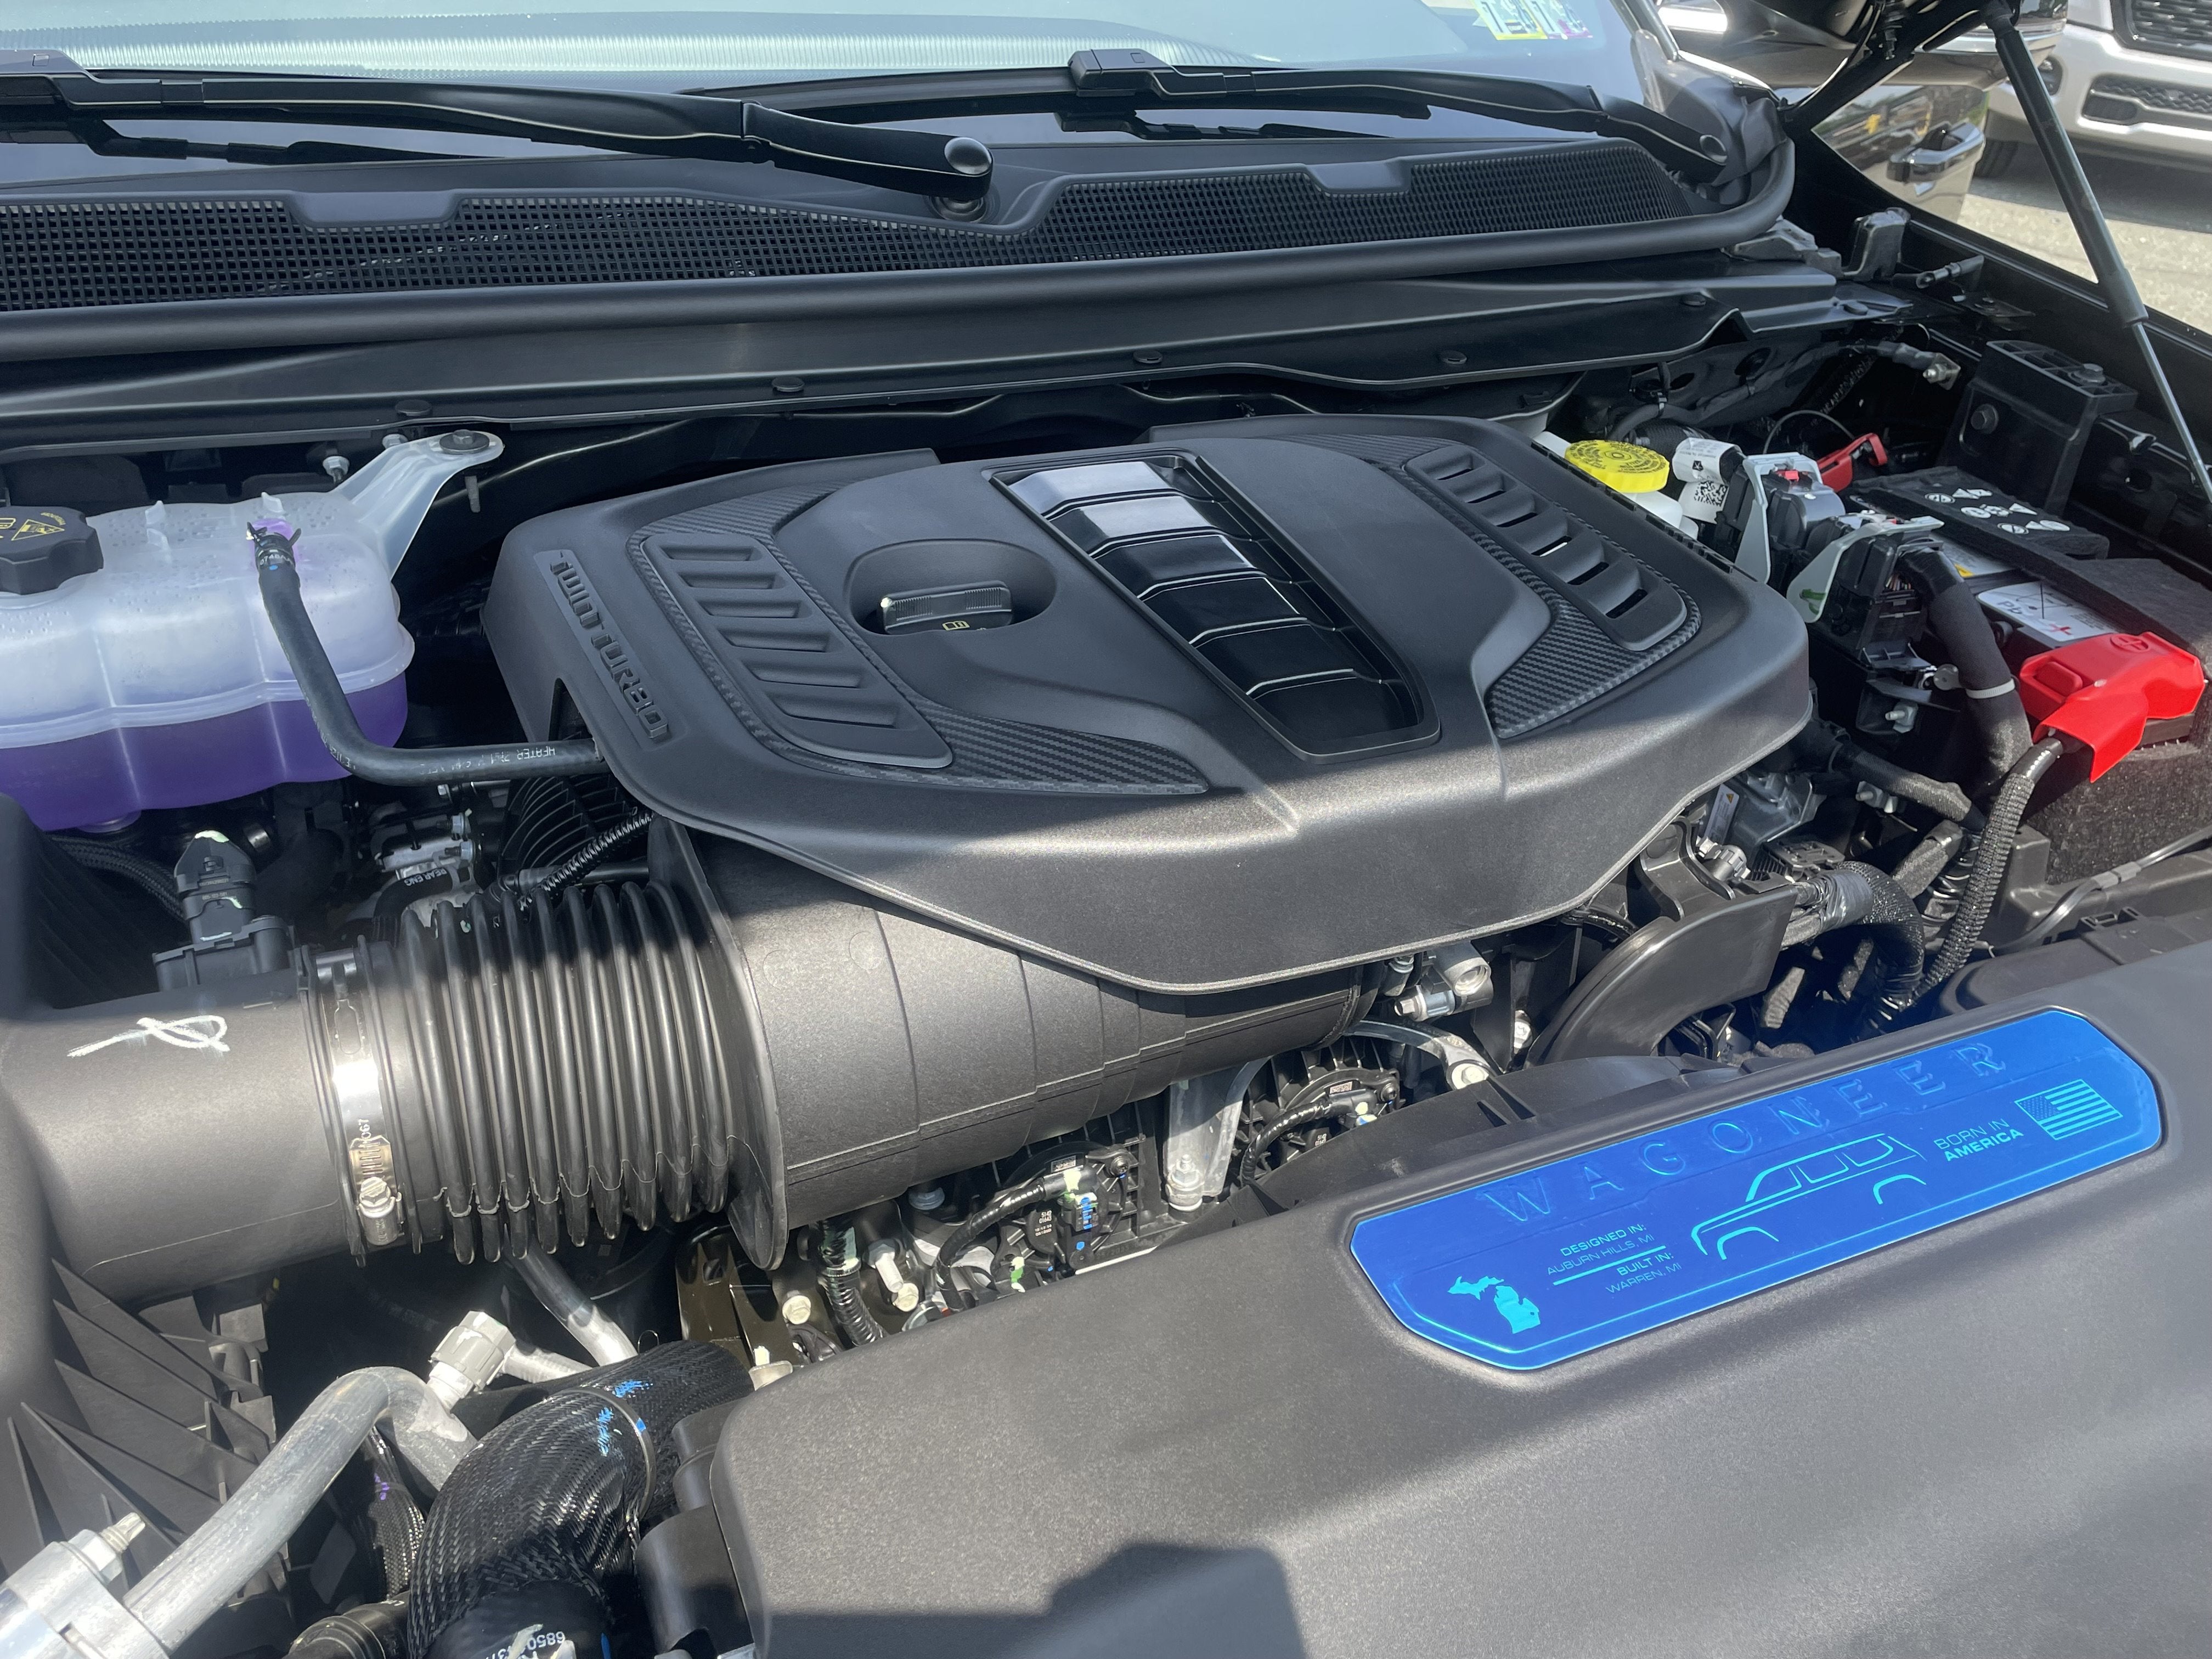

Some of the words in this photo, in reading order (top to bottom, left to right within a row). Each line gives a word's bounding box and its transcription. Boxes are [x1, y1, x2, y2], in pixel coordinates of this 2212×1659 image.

[550, 551, 601, 629] TWIN
[590, 622, 669, 739] TURBO
[1477, 1042, 2006, 1222] WAGONEER
[1933, 1125, 1988, 1149] BORN
[1988, 1118, 2010, 1131] IN
[1944, 1128, 2024, 1162] AMERICA
[1547, 1252, 1600, 1275] AUBURN
[1600, 1240, 1639, 1257] HILLS,
[1638, 1234, 1655, 1244] MI
[1560, 1229, 1627, 1256] DESIGNED
[1627, 1223, 1647, 1234] IN:
[1605, 1269, 1667, 1294] WARREN,
[1665, 1262, 1683, 1273] MI
[1616, 1257, 1653, 1276] BUILT
[1655, 1251, 1674, 1262] IN:
